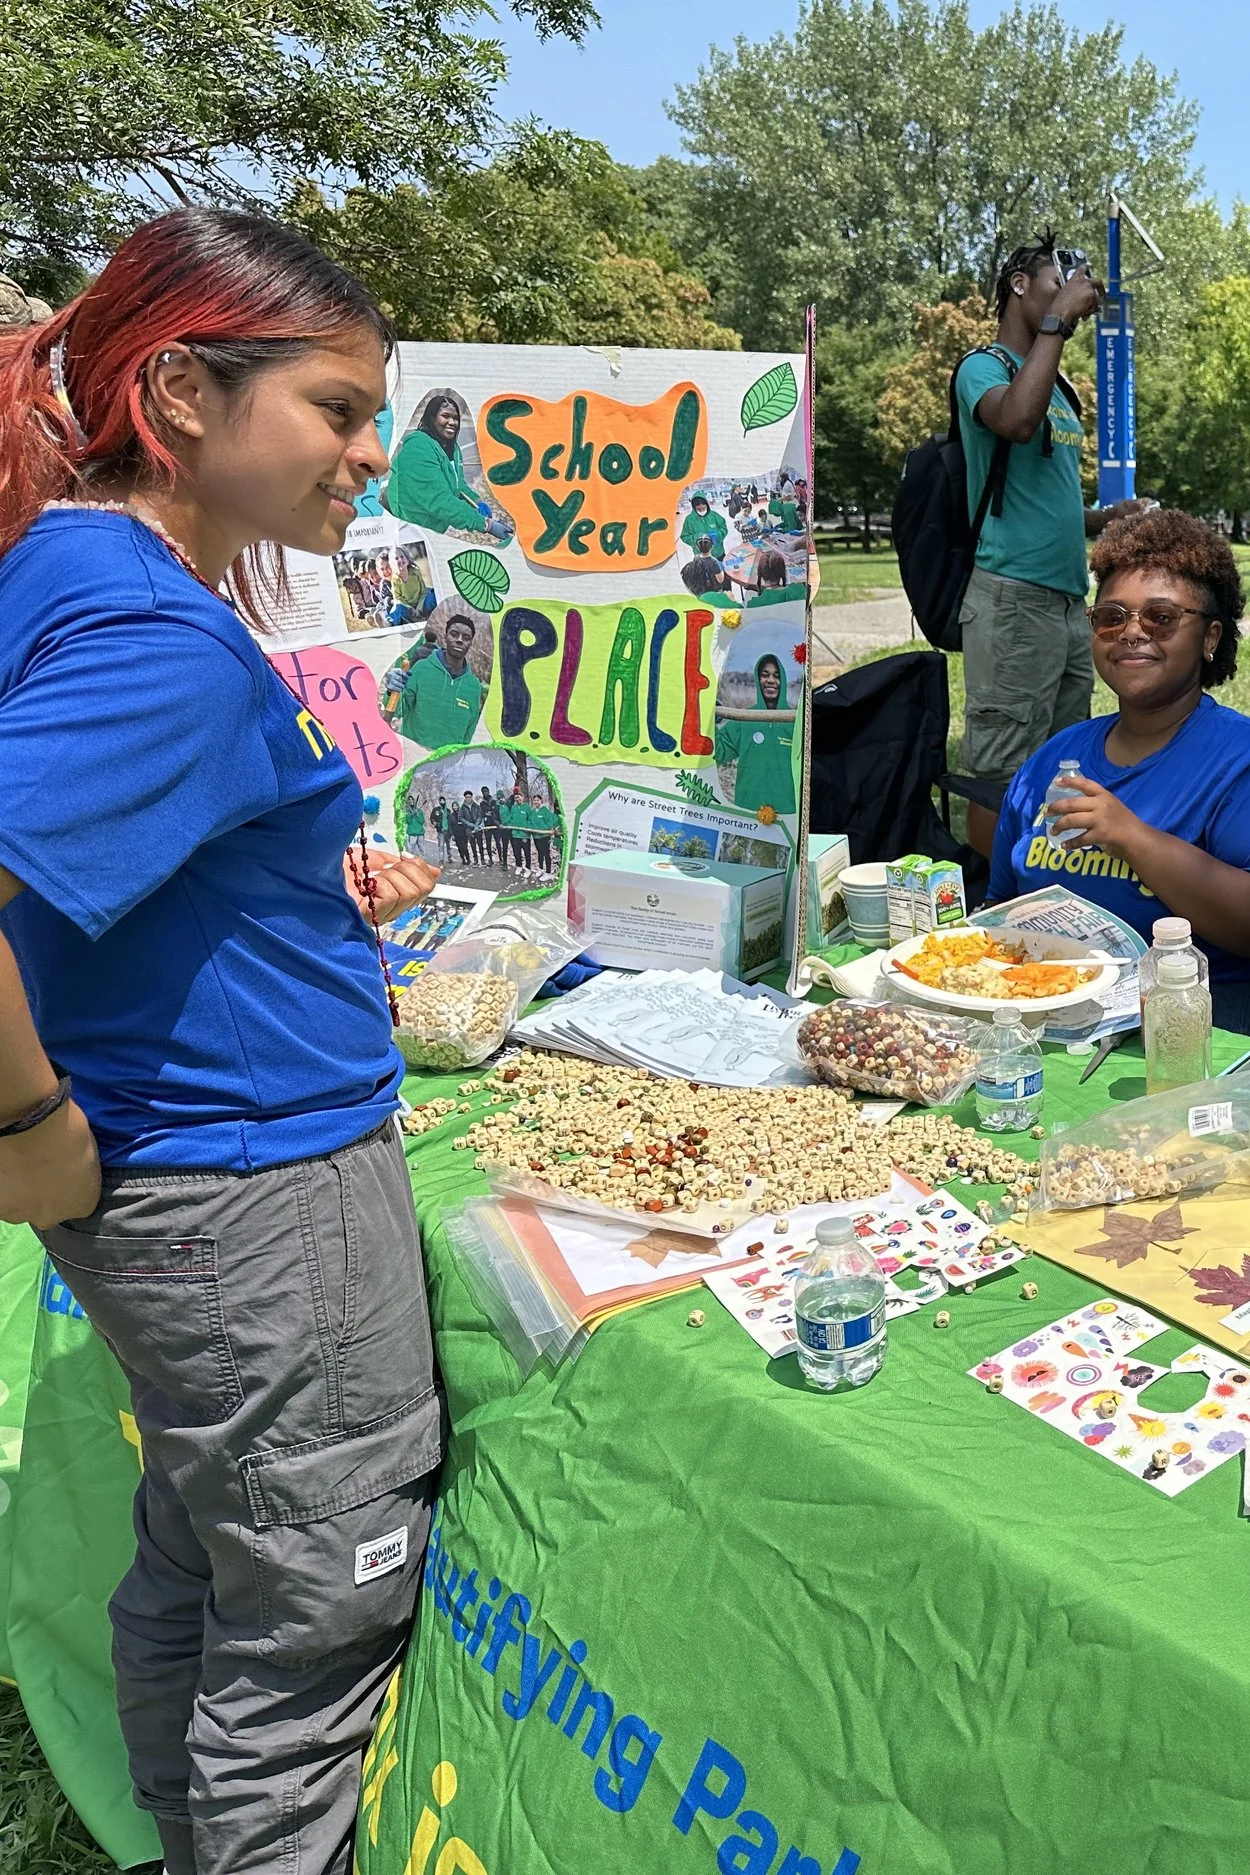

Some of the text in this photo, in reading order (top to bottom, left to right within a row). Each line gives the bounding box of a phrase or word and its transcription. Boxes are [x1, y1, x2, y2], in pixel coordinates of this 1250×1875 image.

[1106, 337, 1116, 440] EMERGENCY
[486, 389, 700, 486] School
[531, 489, 668, 556] Year
[608, 791, 758, 831] Why are Street Trees Important?
[1026, 836, 1154, 897] Bloomin
[362, 1540, 402, 1563] TOMMY
[379, 1549, 402, 1566] JEANS
